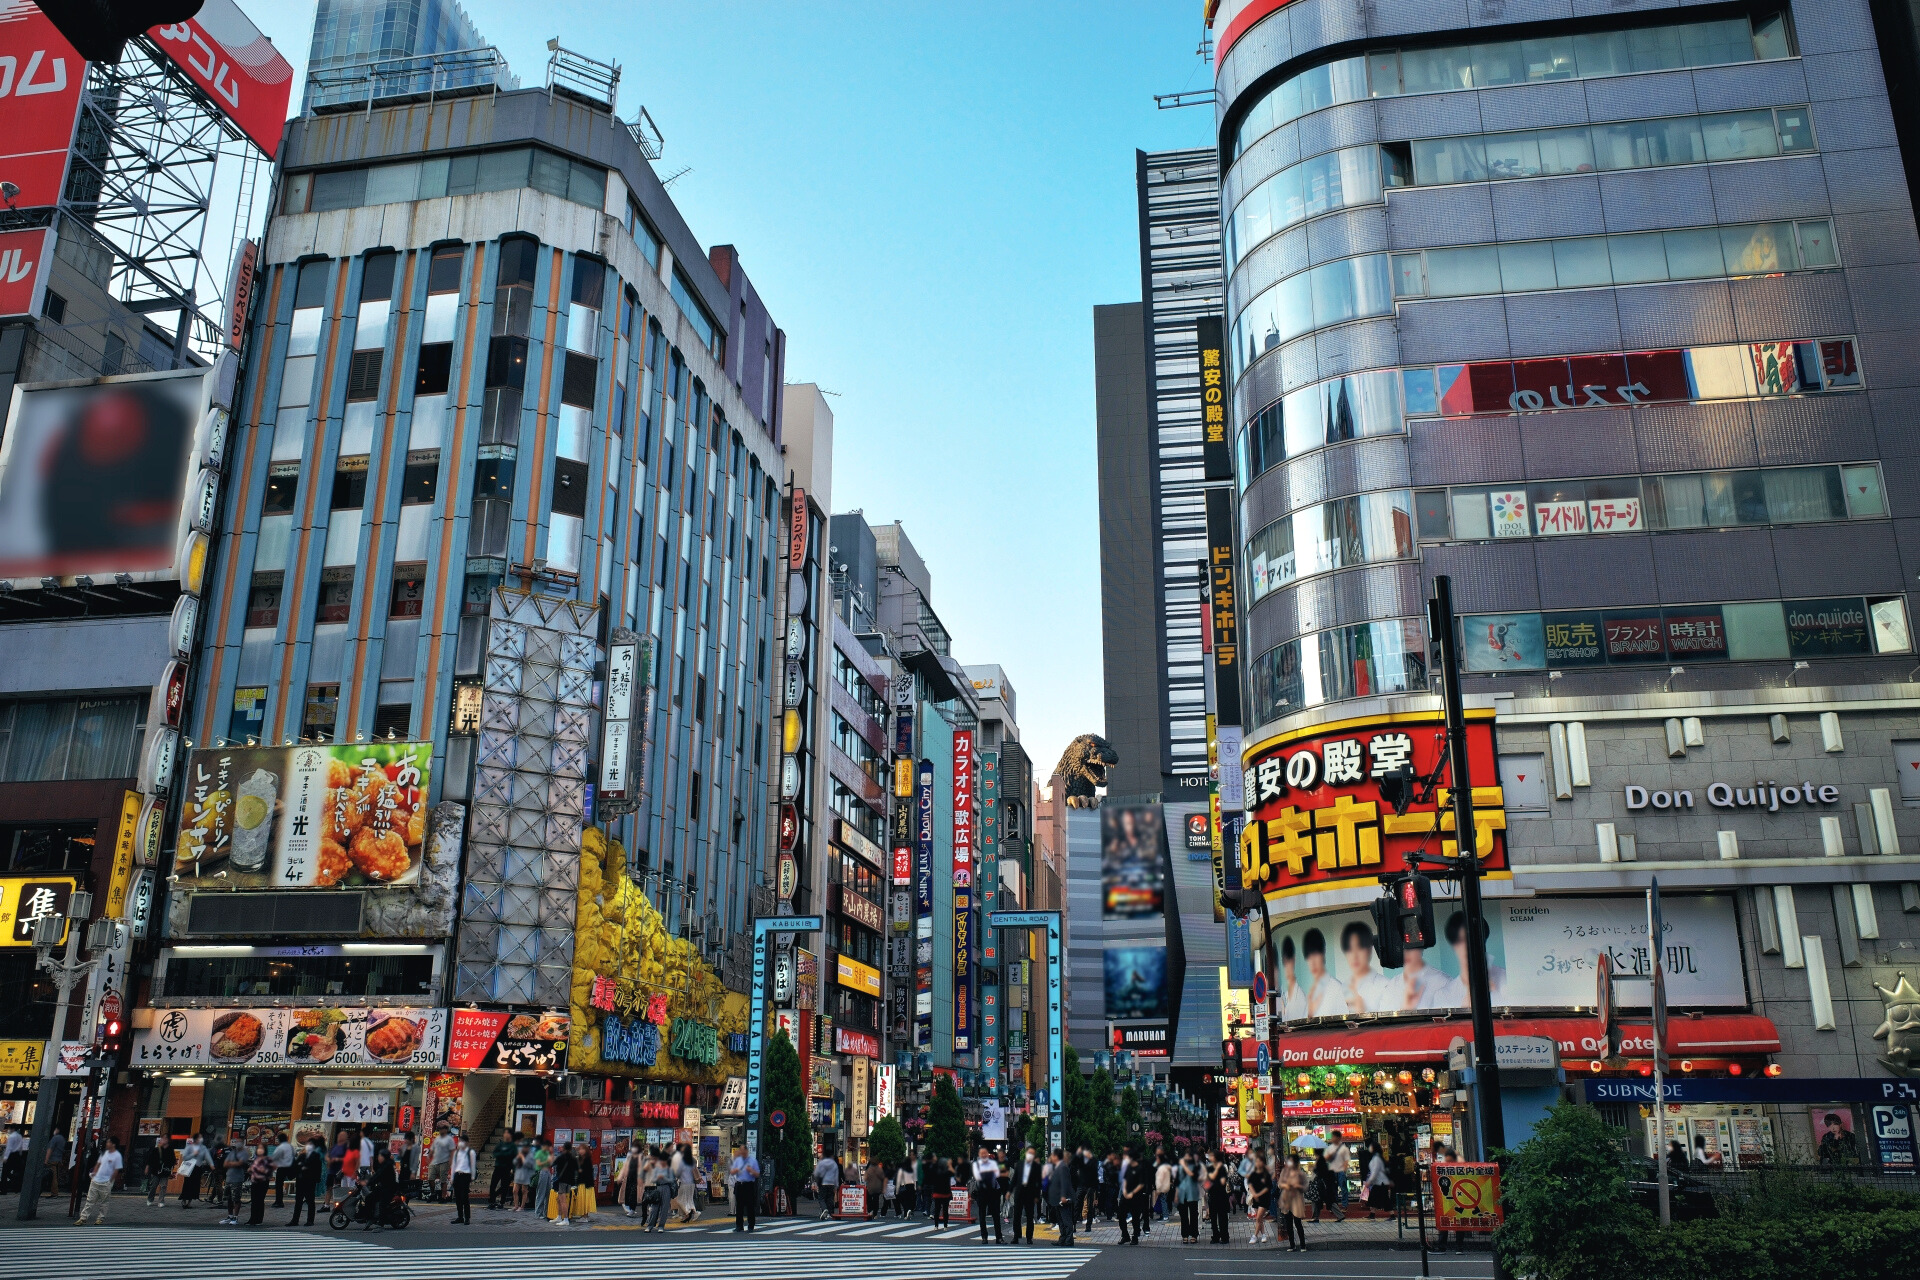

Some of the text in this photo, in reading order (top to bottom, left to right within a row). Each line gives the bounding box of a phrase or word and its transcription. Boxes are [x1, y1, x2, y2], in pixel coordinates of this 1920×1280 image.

[1203, 349, 1224, 443] 驚安の殿堂
[1538, 501, 1638, 532] アイドル ステージ
[1498, 529, 1527, 537] STAGE
[1670, 620, 1720, 638] 時計
[1789, 610, 1865, 630] don.quijote
[1547, 622, 1598, 648] 販売
[1608, 625, 1658, 641] ブランド
[1789, 630, 1867, 648] ドン・キホーテ
[1610, 639, 1660, 655] BRAND
[1671, 636, 1722, 650] WATCH
[462, 714, 477, 731] 光
[608, 768, 619, 781] 光
[1244, 732, 1414, 811] 驚安の殿堂
[356, 758, 377, 815] チキンが
[955, 736, 970, 863] カラオケ歌広場
[1625, 780, 1839, 812] Don Quijote
[335, 784, 351, 838] たべたい。
[374, 784, 398, 840] 猛烈に
[190, 763, 213, 879] レモンサワー
[292, 815, 309, 836] 光
[1187, 853, 1211, 861] IMA
[285, 866, 304, 881] 4F
[134, 882, 151, 920] かっぱ
[848, 893, 878, 928] 山内農場
[1509, 906, 1550, 915] Torriden
[134, 924, 144, 933] B1
[772, 920, 812, 928] KABUKI町
[1563, 922, 1673, 940] うるおいに、とびめ
[956, 911, 969, 977] マツモトキヨシ
[777, 962, 788, 989] かっぱ
[163, 1012, 185, 1041] 虎
[265, 1012, 275, 1030] そば
[429, 1009, 443, 1049] かつ丼
[456, 1017, 499, 1028] お好み焼き
[750, 946, 765, 1094] GODZILLA ROAD
[274, 1011, 284, 1048] かき揚げ
[344, 1012, 354, 1051] ラーメン
[353, 1011, 366, 1050] とんこつ
[455, 1029, 498, 1039] もんじゃ焼き
[1126, 1030, 1166, 1042] MARUHAN
[453, 1040, 488, 1050] 焼きそば
[554, 1042, 565, 1050] 2F
[670, 1017, 718, 1066] 24時間
[1495, 1044, 1549, 1054] 心ステーション
[140, 1044, 195, 1061] とらそば
[256, 1051, 284, 1064] 580円
[412, 1051, 441, 1064] 590円
[452, 1052, 469, 1062] ピザ
[496, 1041, 557, 1067] とらぢゅう
[1283, 1046, 1364, 1063] Don Quijote
[1597, 1083, 1683, 1099] SUBNADE
[1882, 1083, 1894, 1098] P
[327, 1101, 388, 1119] とらそば
[855, 1109, 864, 1120] 集
[1876, 1110, 1894, 1135] P
[1436, 1166, 1495, 1176] 新宿区内全域
